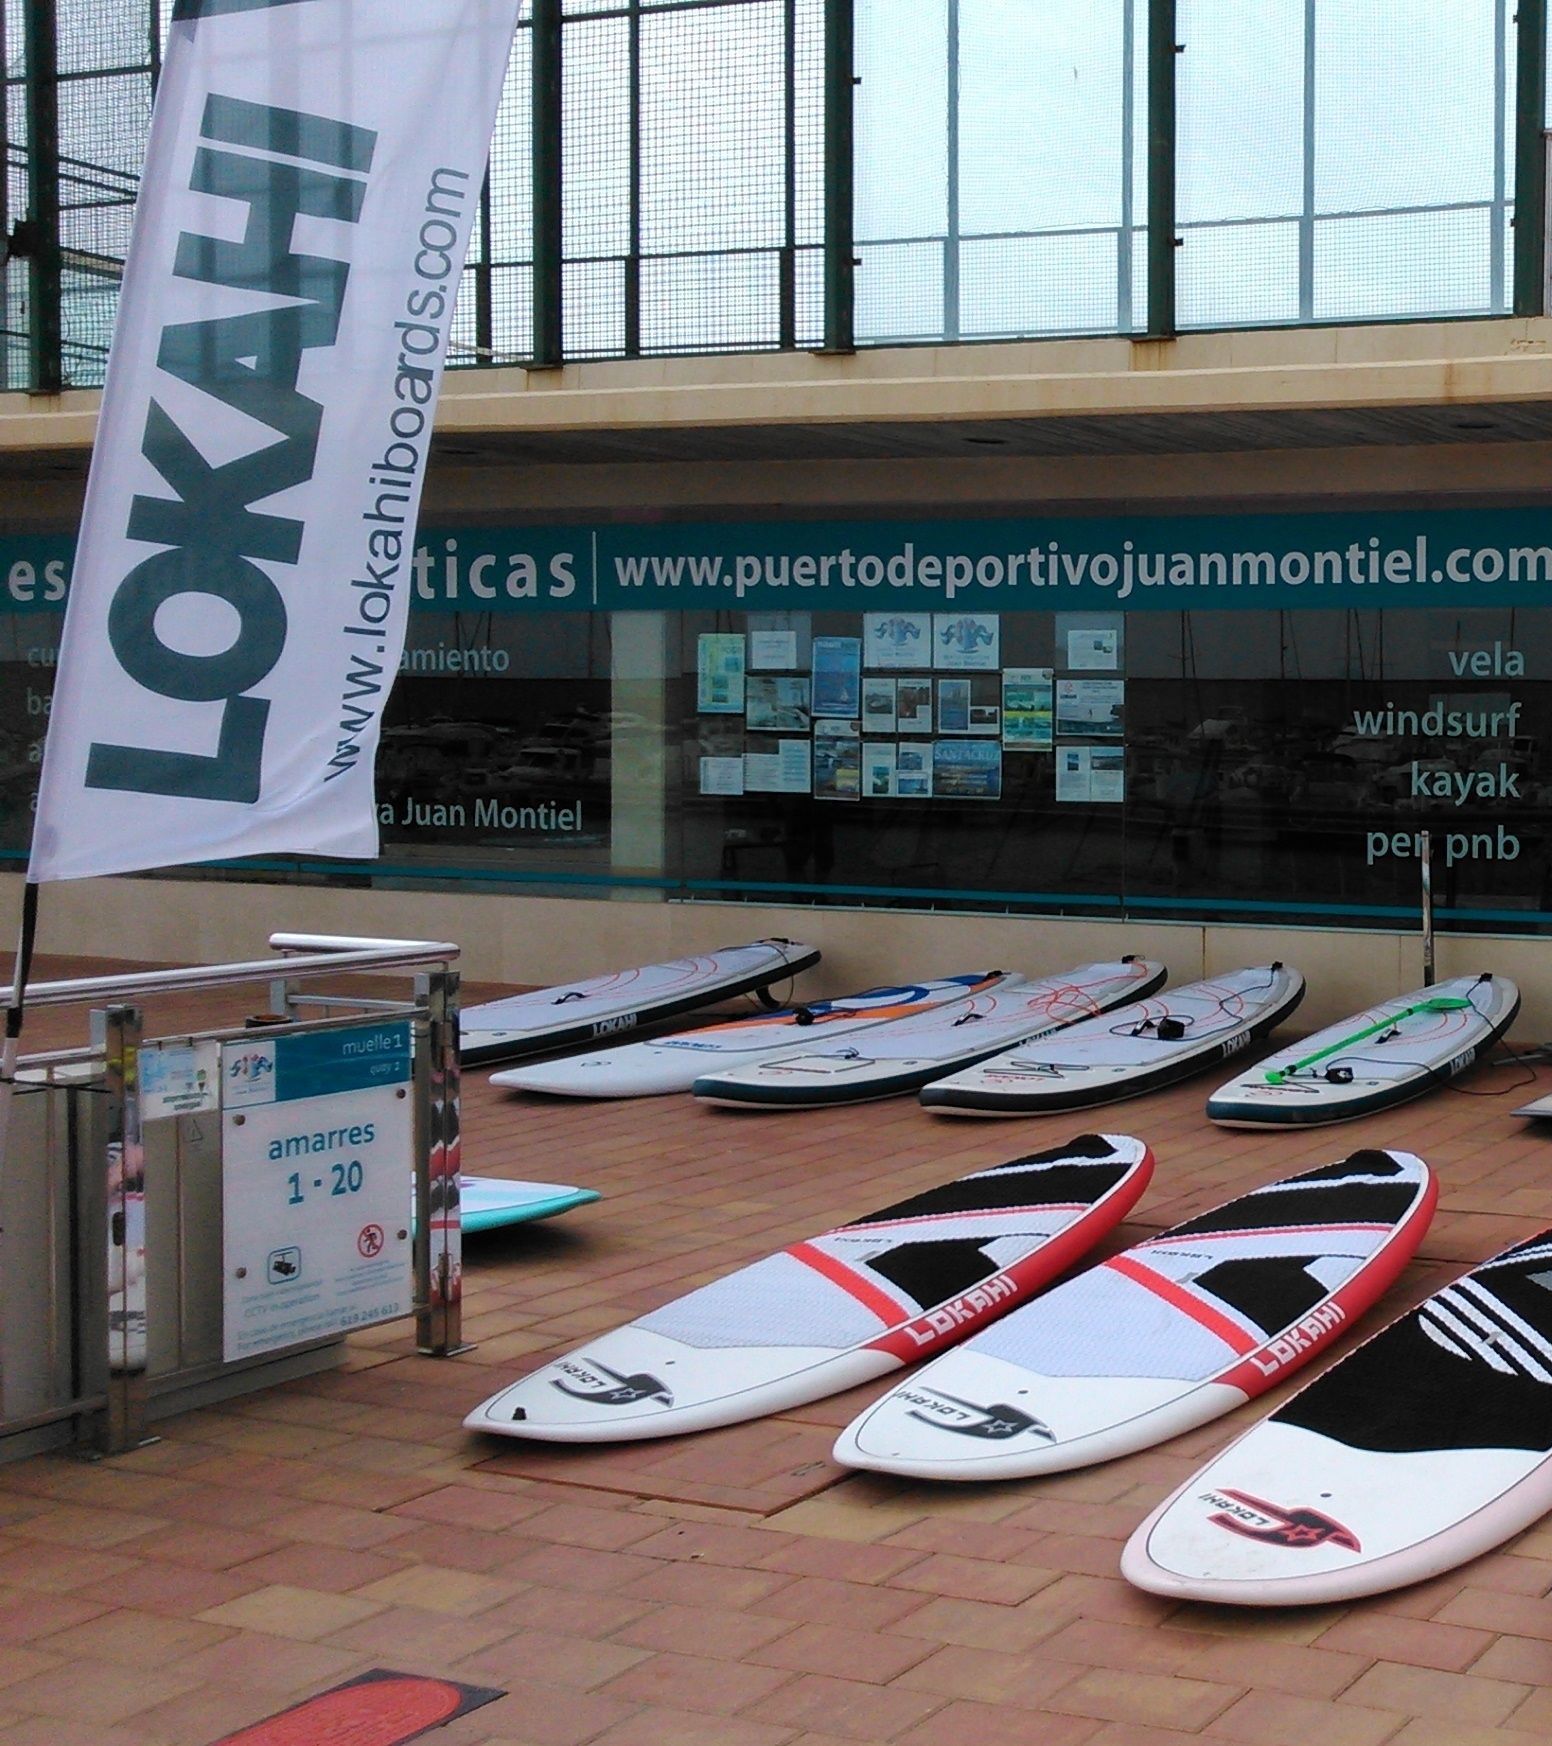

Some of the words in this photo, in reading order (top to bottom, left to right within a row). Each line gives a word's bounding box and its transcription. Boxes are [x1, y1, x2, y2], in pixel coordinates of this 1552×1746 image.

[84, 93, 378, 803] LOKAHI
[1449, 642, 1525, 677] vela
[1353, 702, 1521, 738] windsurf
[1411, 761, 1520, 806] kayak
[402, 797, 466, 827] Juan
[474, 799, 582, 831] Montiel
[1446, 825, 1520, 867] pnb
[342, 1034, 391, 1055] muelle
[393, 1034, 403, 1048] 1
[592, 1013, 638, 1039] LOKAHI
[268, 1122, 375, 1161] amarres
[288, 1172, 304, 1205] 1
[331, 1160, 363, 1196] 20
[904, 1275, 1019, 1346] LOKAHI
[1249, 1301, 1347, 1377] LOKAHI
[893, 1390, 972, 1421] LOKAHI
[1198, 1492, 1271, 1526] LOKAHI
